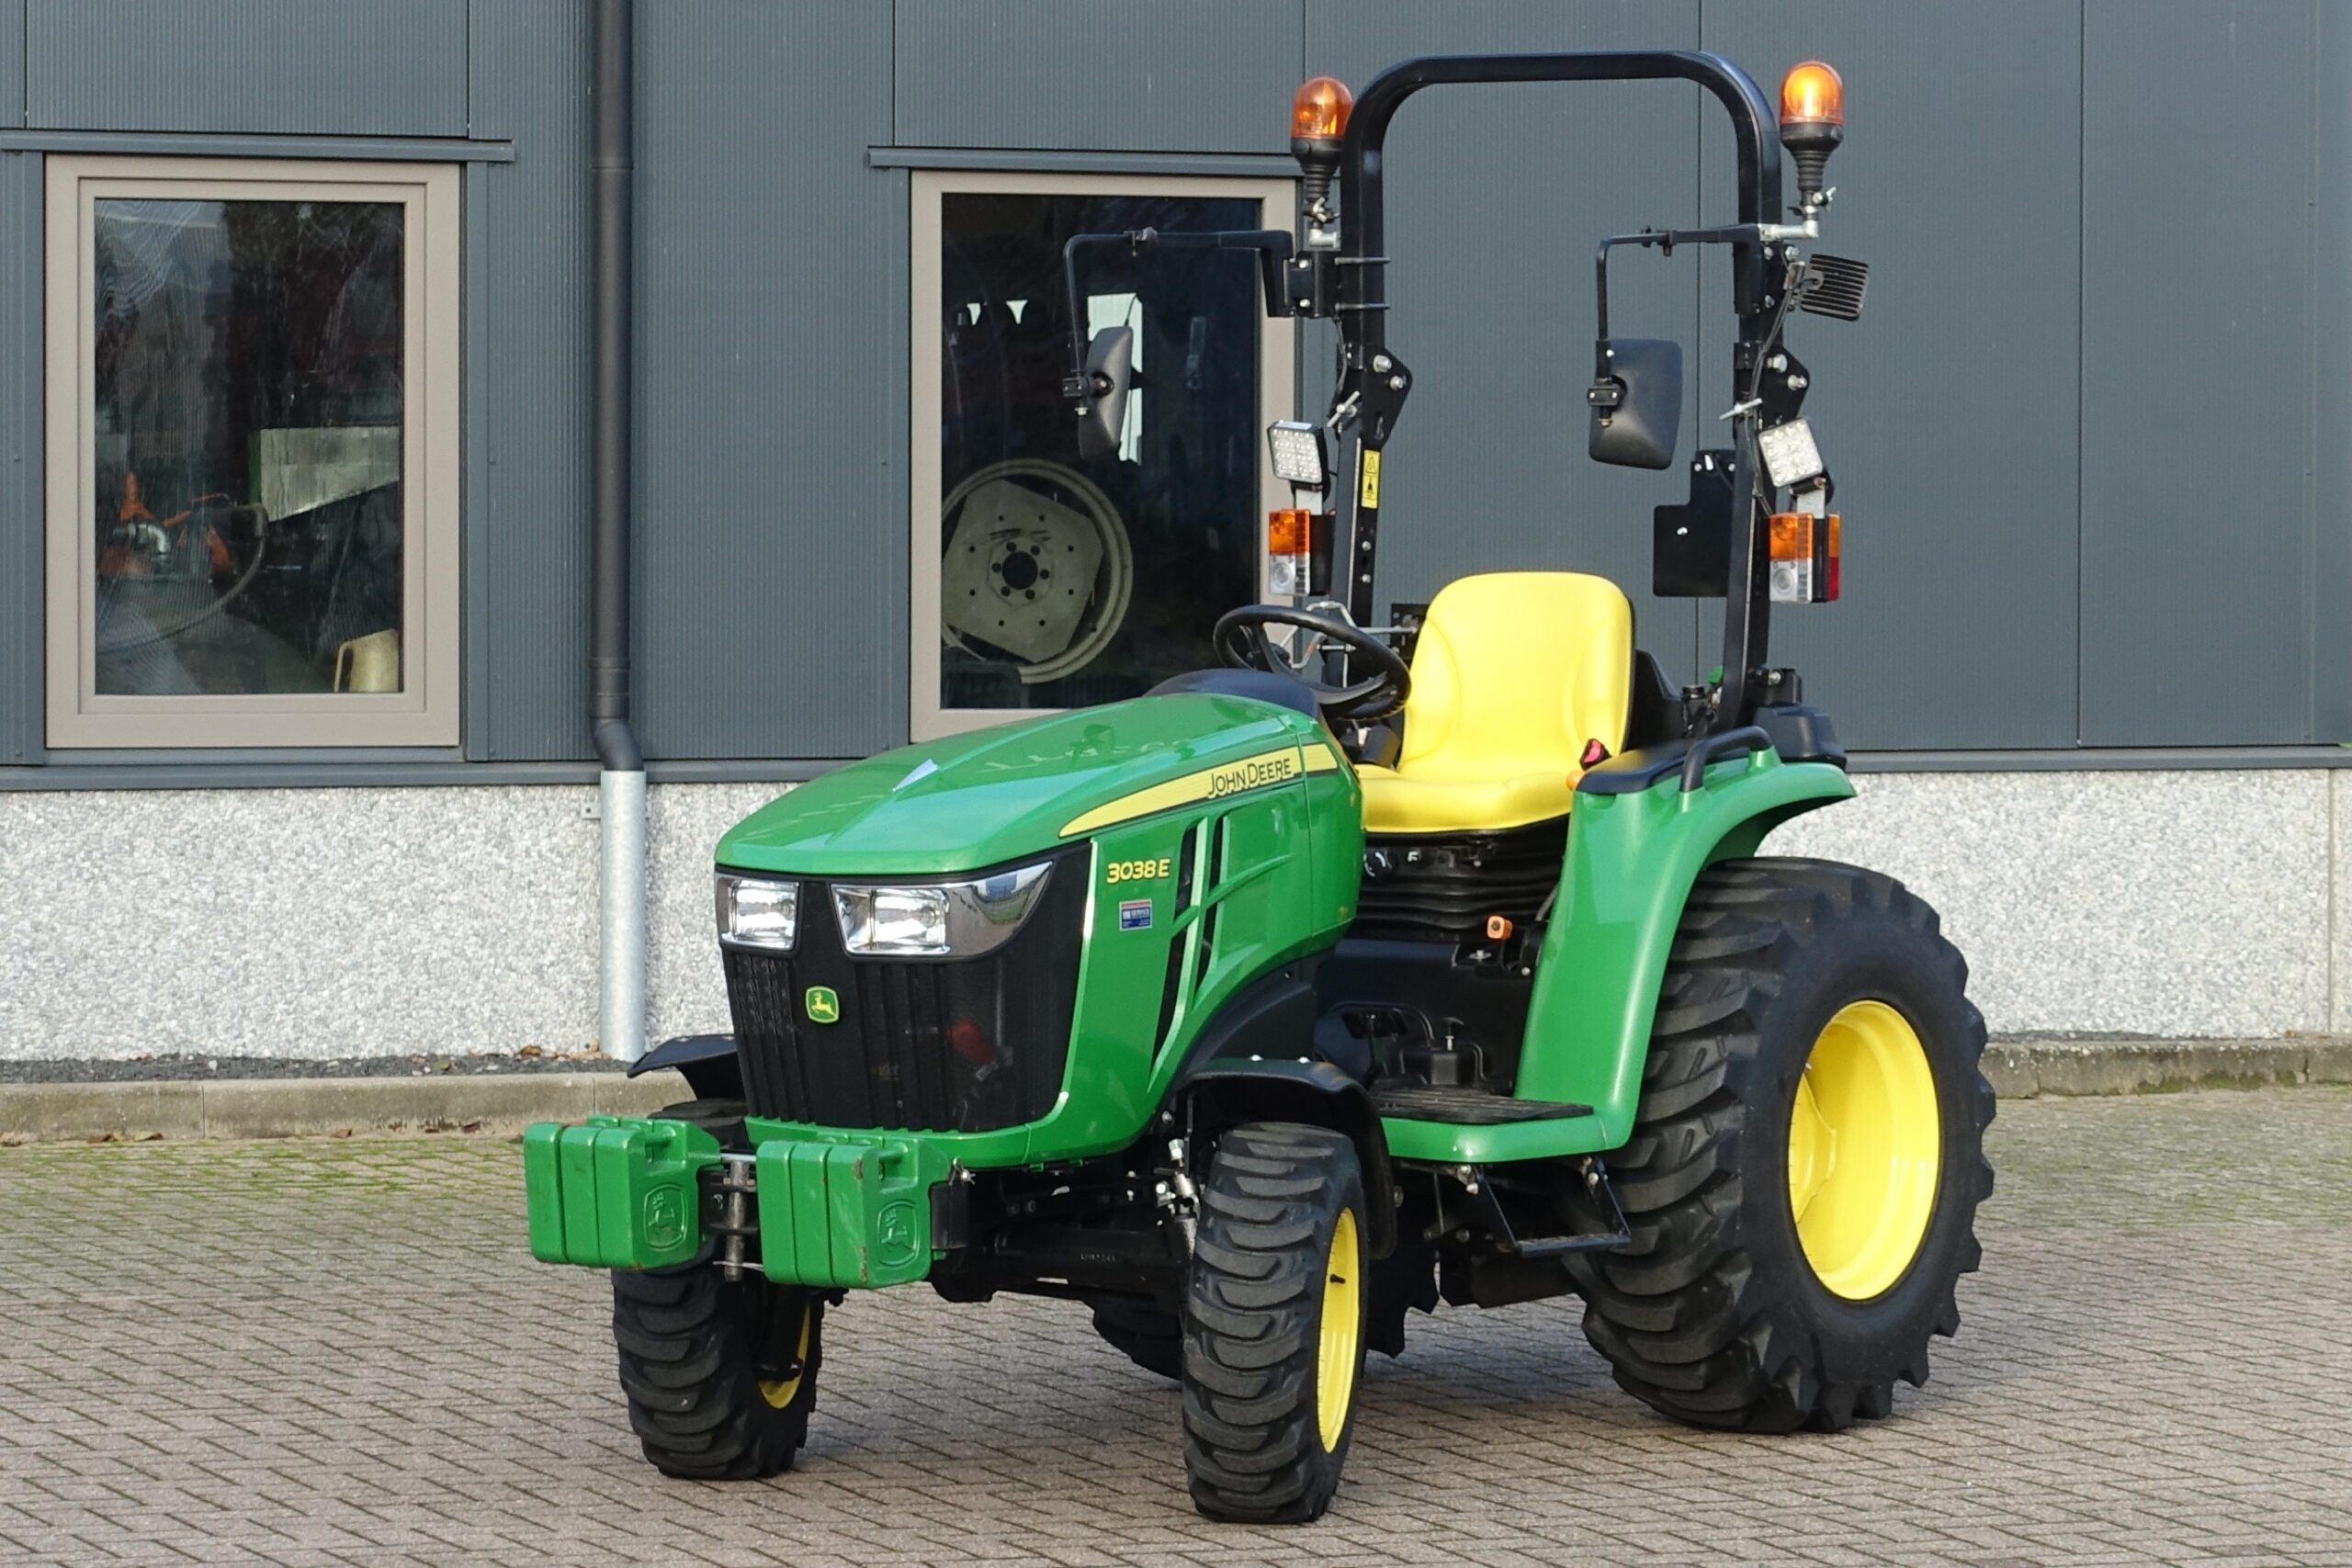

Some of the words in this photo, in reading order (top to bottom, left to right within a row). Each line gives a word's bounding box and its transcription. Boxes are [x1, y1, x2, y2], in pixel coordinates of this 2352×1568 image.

[1207, 769, 1246, 795] JOHN
[1247, 758, 1291, 784] DEERE
[1106, 858, 1170, 884] 3038E
